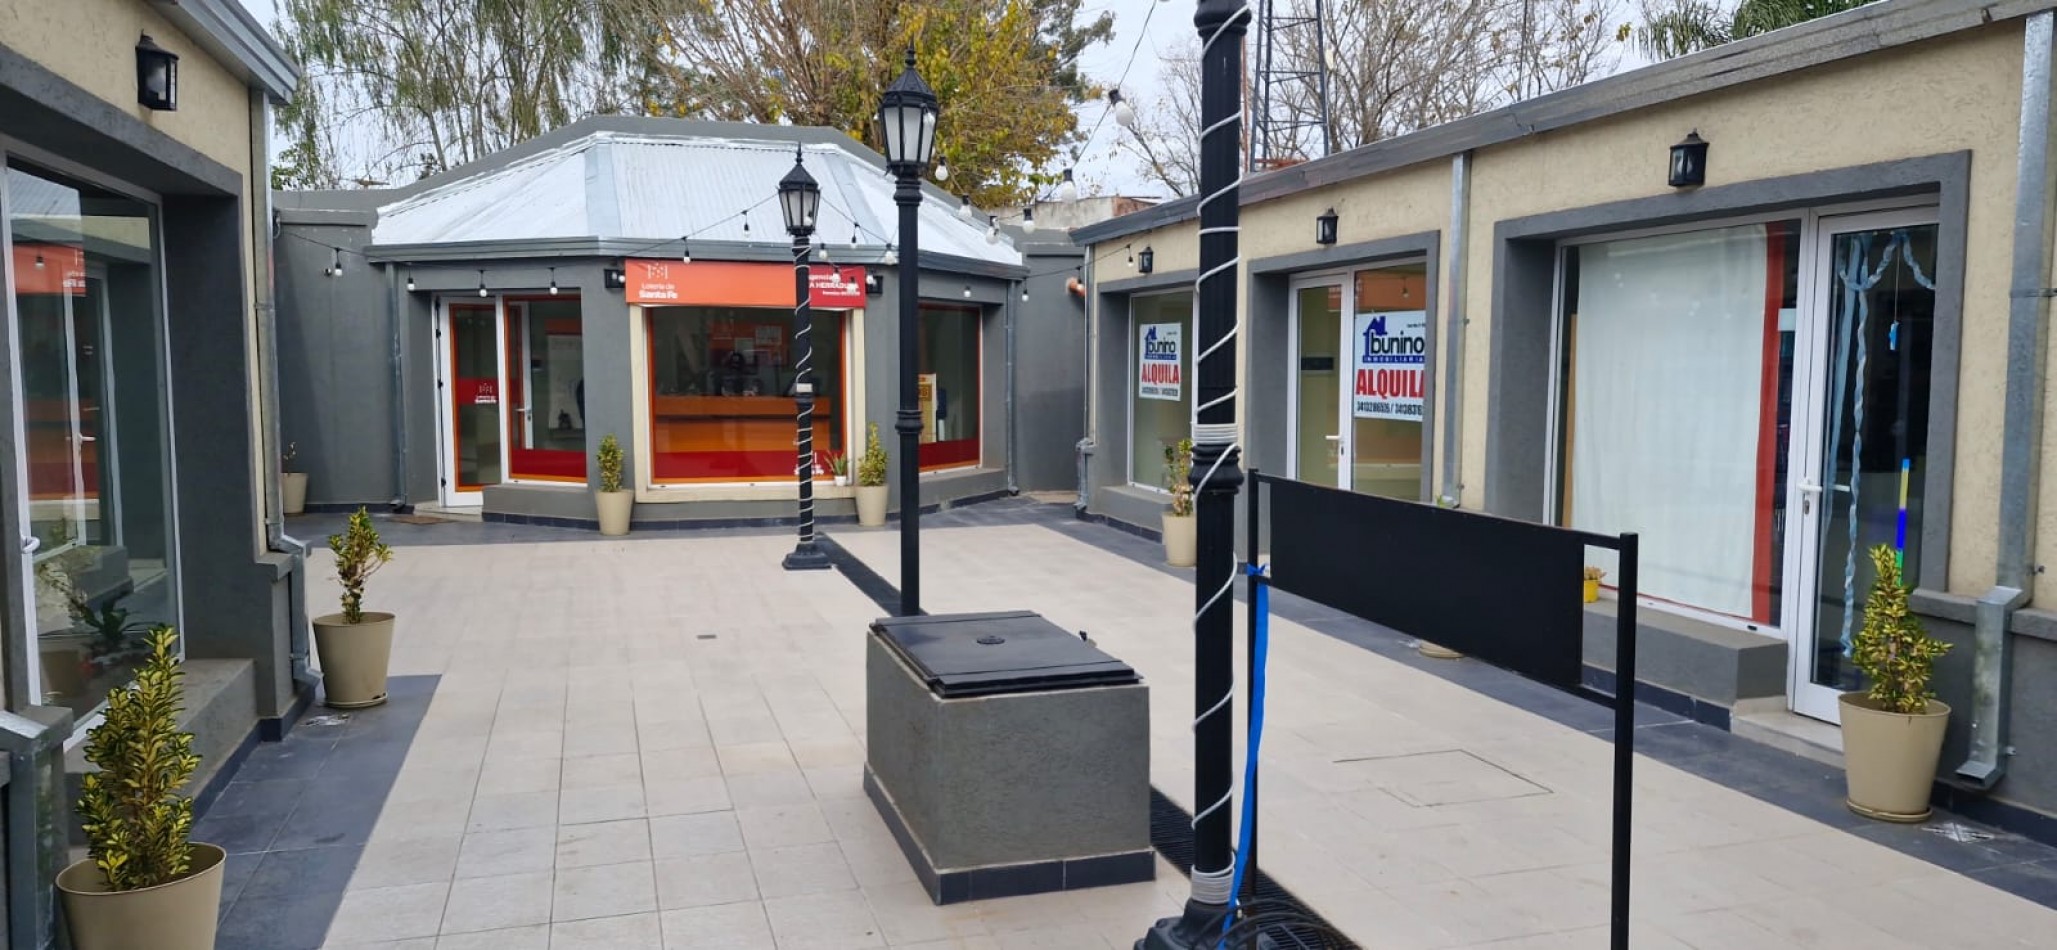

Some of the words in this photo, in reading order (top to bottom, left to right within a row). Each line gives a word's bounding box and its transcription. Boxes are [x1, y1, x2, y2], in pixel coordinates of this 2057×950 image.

[639, 289, 666, 299] Santa
[1371, 329, 1425, 354] bunino
[1141, 363, 1180, 385] ALQUILA
